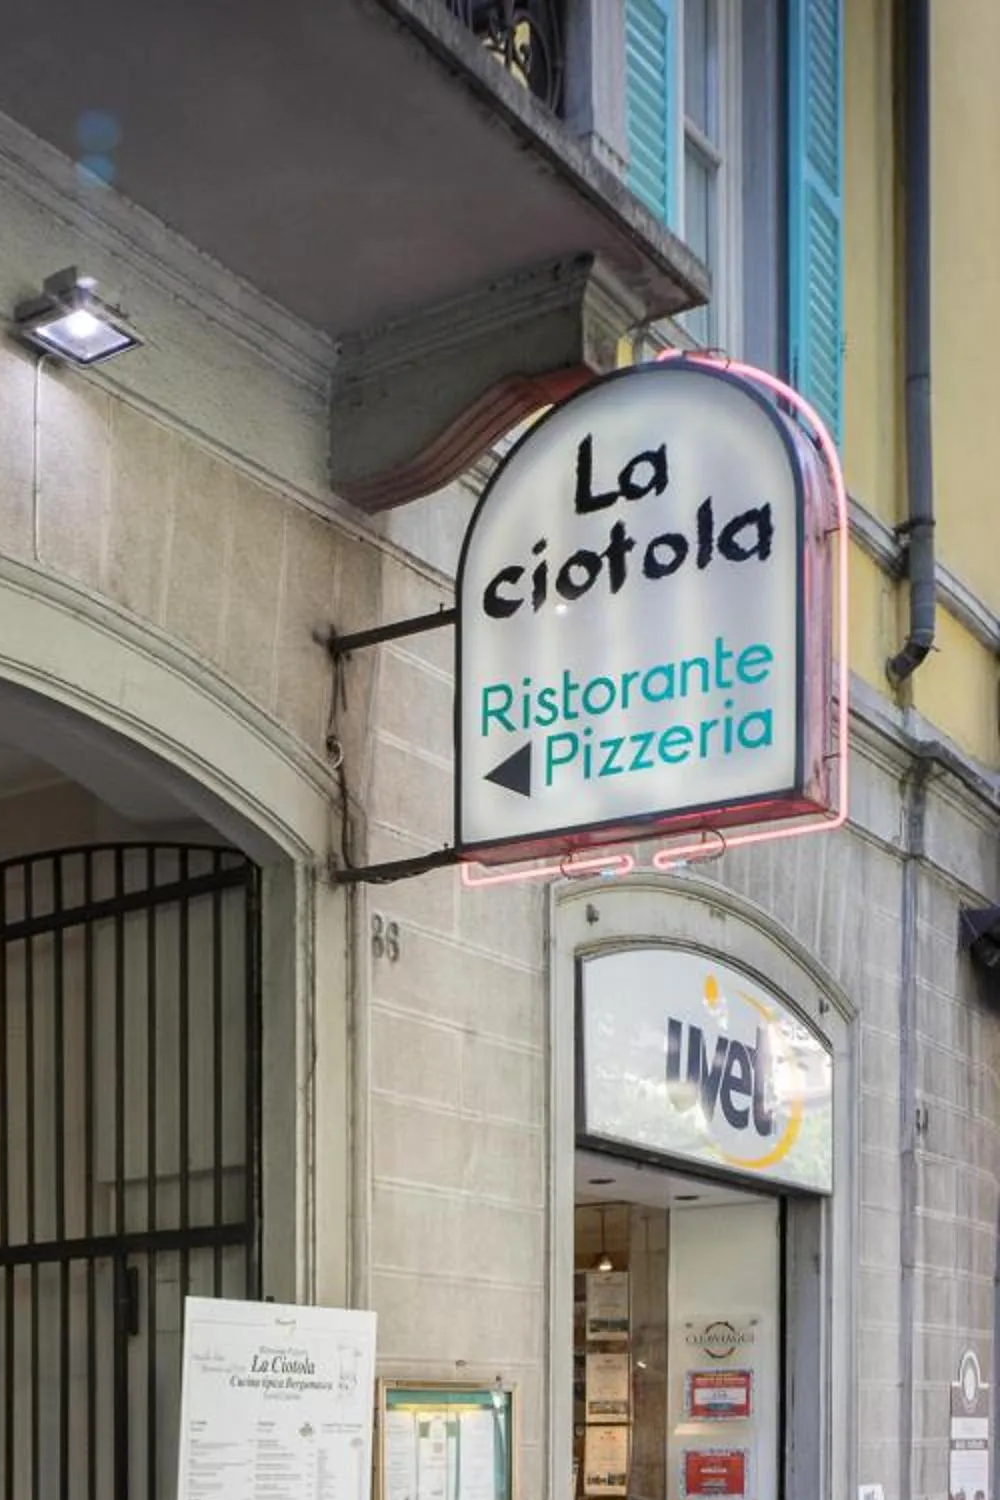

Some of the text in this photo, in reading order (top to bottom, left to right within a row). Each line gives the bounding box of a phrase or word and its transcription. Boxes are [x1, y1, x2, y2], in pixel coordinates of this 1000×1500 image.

[574, 433, 669, 515] La
[481, 496, 774, 620] ciotola
[481, 636, 774, 737] Ristorante
[545, 701, 774, 786] Pizzeria
[371, 913, 400, 962] 88
[251, 1354, 269, 1373] La
[271, 1354, 316, 1375] Ciotola
